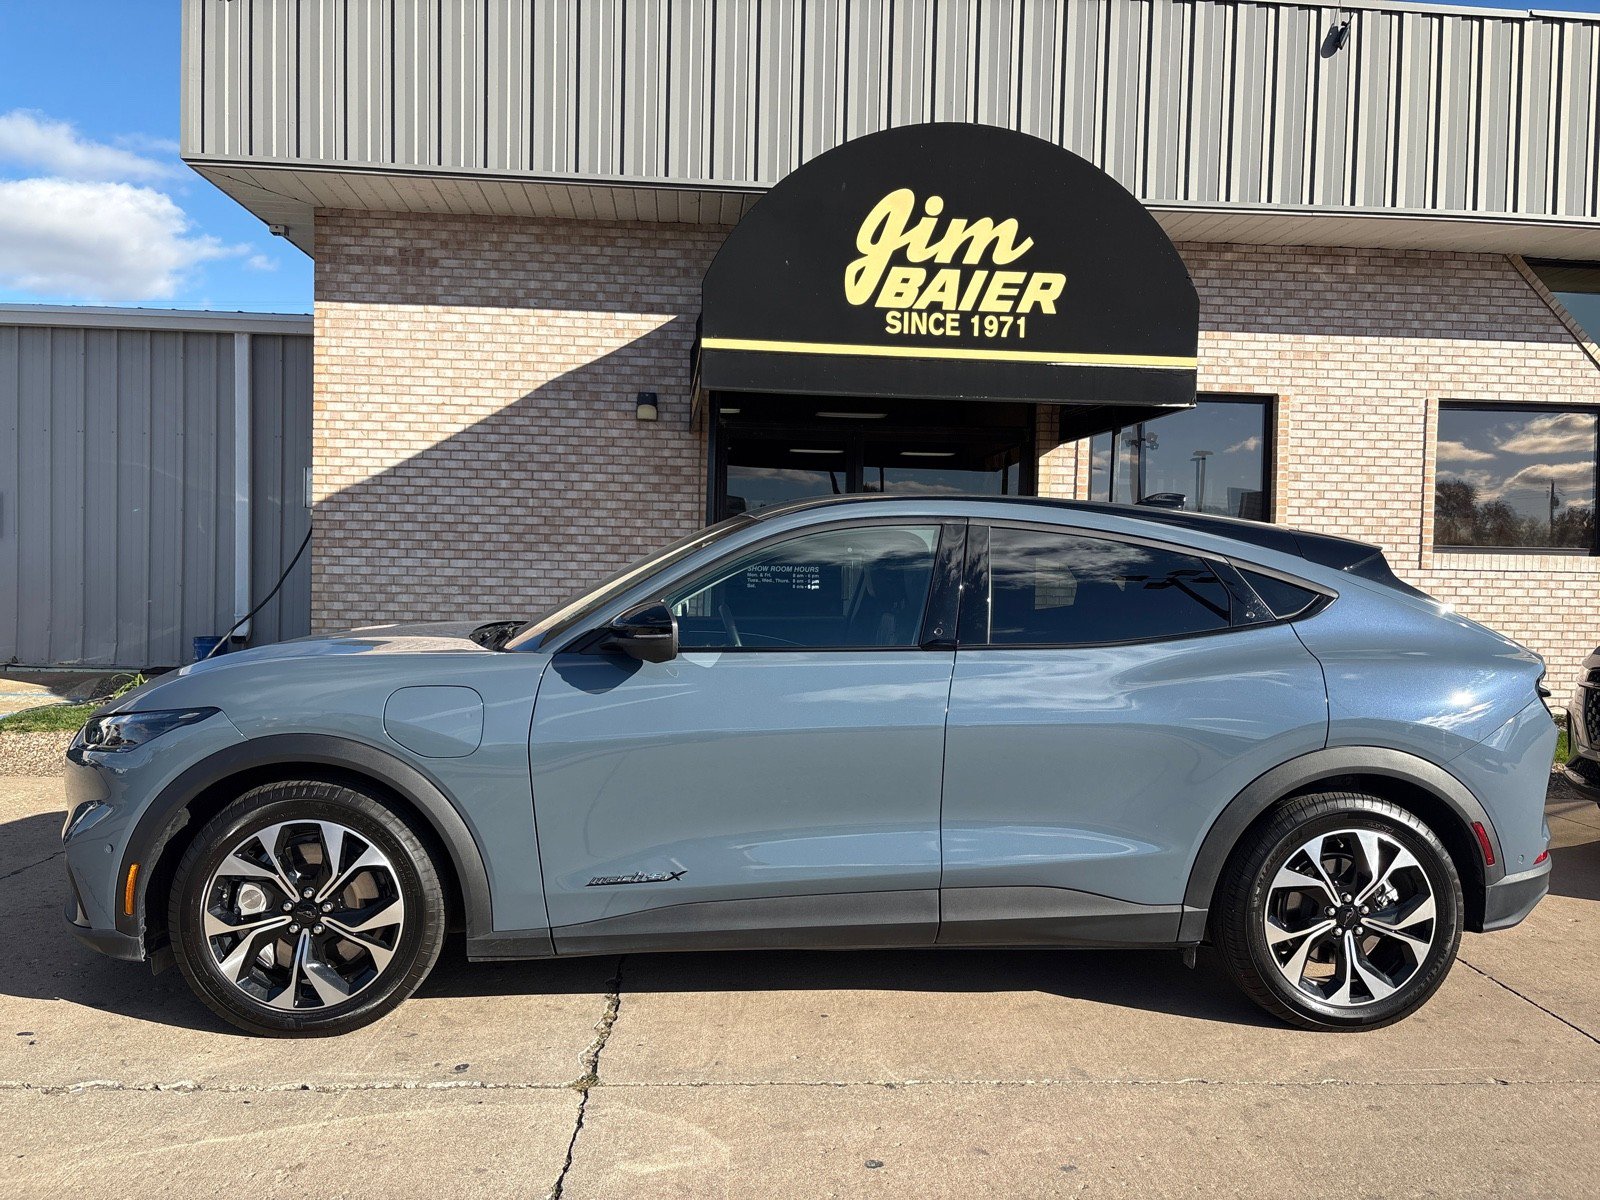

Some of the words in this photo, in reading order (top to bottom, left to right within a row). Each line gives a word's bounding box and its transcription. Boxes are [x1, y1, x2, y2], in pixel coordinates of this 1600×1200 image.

[844, 188, 1035, 306] Jim
[874, 266, 1067, 315] BAIER
[885, 311, 961, 337] SINCE
[970, 315, 1026, 339] 1971
